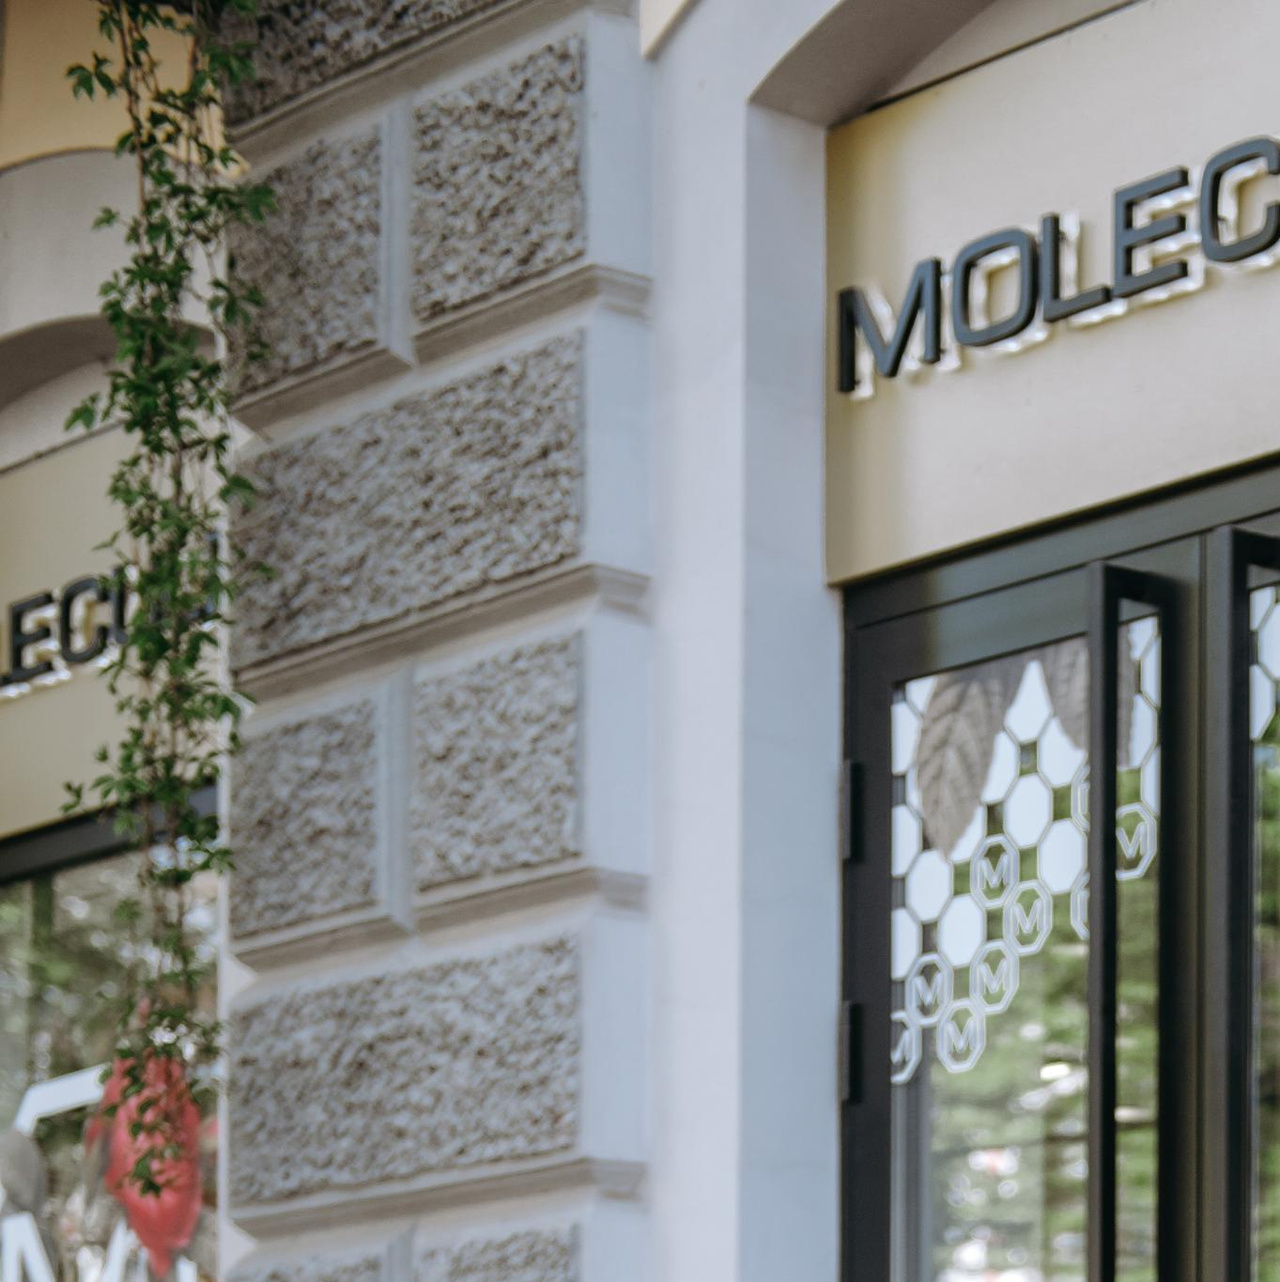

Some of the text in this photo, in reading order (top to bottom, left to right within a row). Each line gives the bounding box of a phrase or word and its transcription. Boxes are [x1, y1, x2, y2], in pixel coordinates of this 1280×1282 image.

[978, 854, 1010, 889] M
[1011, 899, 1043, 936] M
[912, 972, 944, 1006] M
[978, 960, 1010, 995] M
[944, 1017, 977, 1056] M
